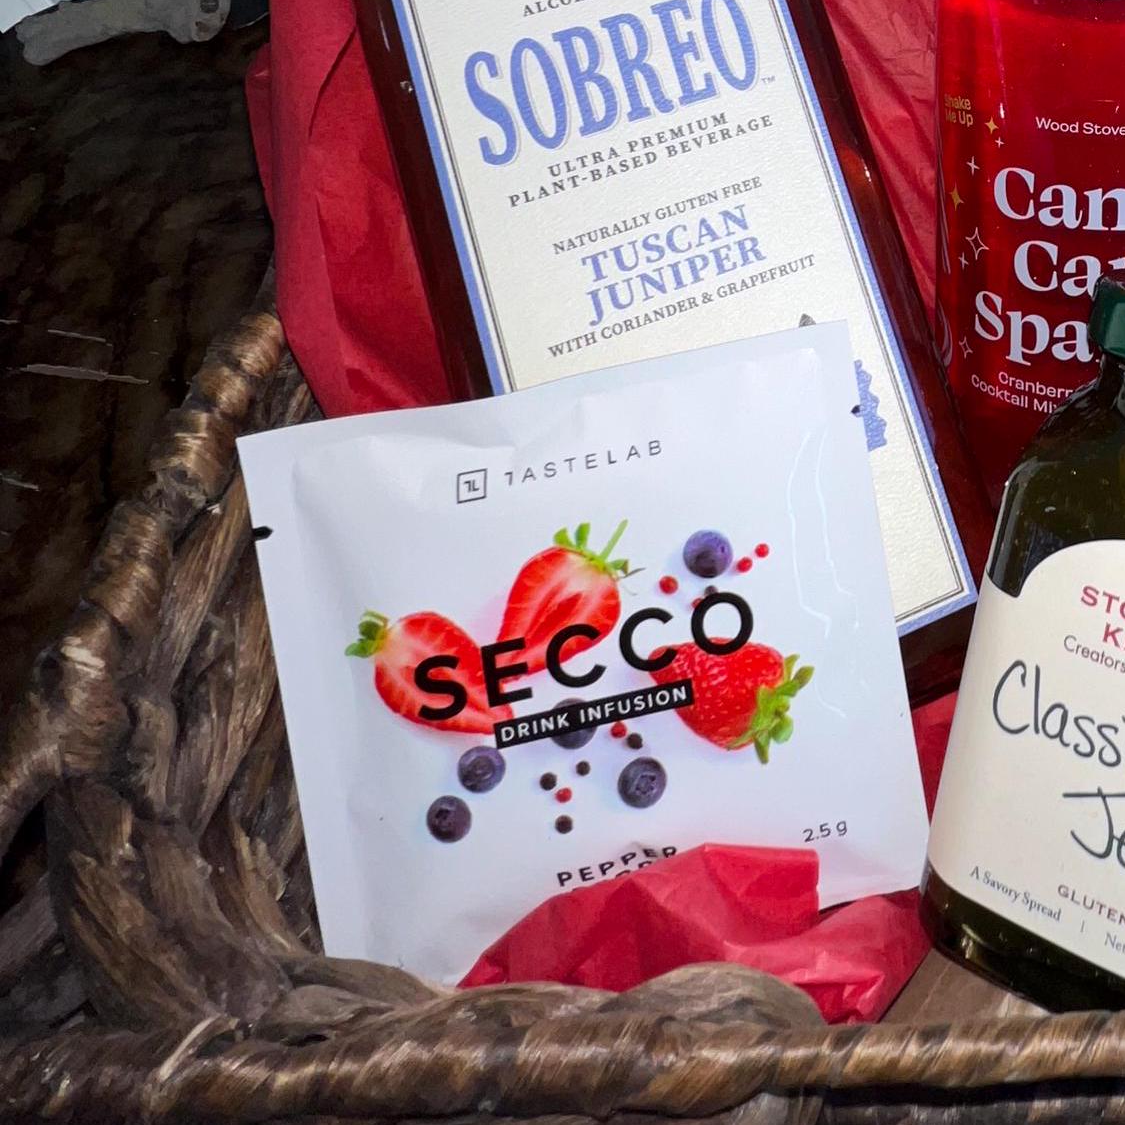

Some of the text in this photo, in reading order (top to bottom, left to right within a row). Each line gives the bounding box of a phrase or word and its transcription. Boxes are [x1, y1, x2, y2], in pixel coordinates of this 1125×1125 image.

[547, 111, 730, 177] ULTRA PREMIUM
[958, 110, 974, 127] Up
[1035, 116, 1079, 134] Wood
[508, 114, 774, 208] PLANT-BASED BEVERAGE
[552, 176, 763, 255] NATURALLY GLUTEN FREE
[580, 204, 751, 283] TUSCAN
[547, 254, 816, 358] WITH CORIANDER & GRAPEFRUIT
[585, 236, 766, 327] JUNIPER
[971, 374, 1057, 414] Cocktail Mi
[413, 591, 754, 722] SECCO
[500, 685, 688, 743] DRINK INFUSION
[969, 866, 1062, 923] A Savory Spread
